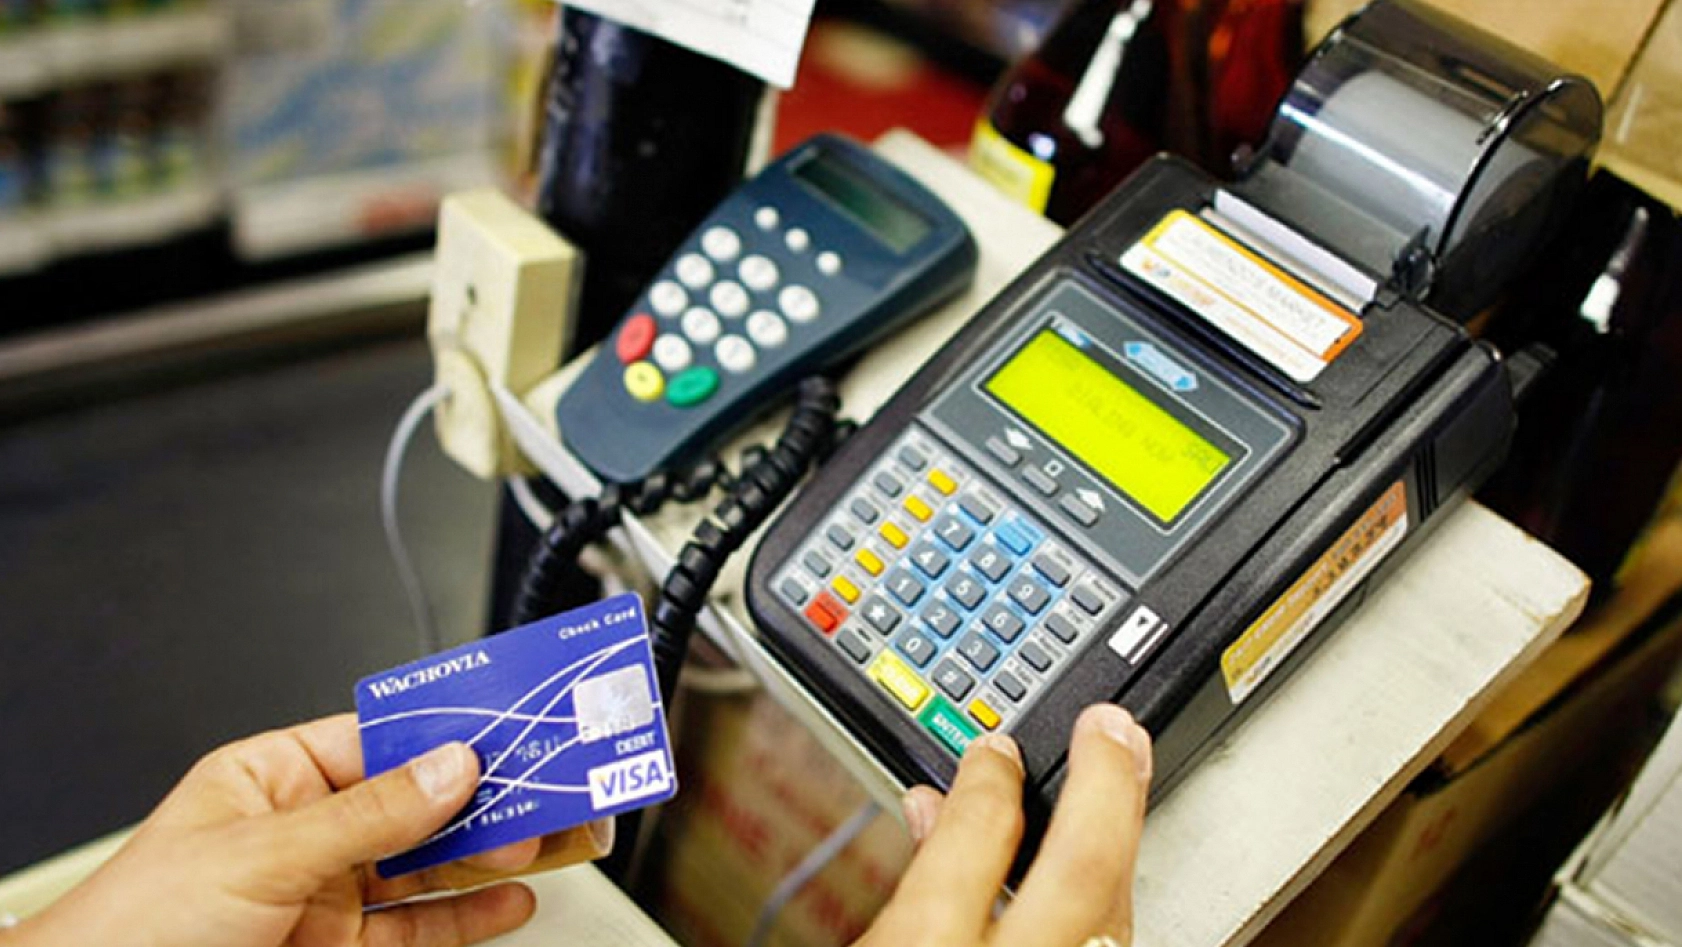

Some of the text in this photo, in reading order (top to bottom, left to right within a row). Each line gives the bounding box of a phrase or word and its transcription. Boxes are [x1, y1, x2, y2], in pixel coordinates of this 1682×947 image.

[944, 521, 960, 538] 7
[918, 550, 934, 567] 4
[980, 553, 996, 569] 8
[895, 577, 910, 594] 1
[954, 580, 971, 597] 5
[1018, 583, 1034, 599] 9
[558, 606, 637, 640] Check Card
[930, 608, 947, 625] 2
[993, 611, 1008, 628] 6
[905, 637, 921, 655] 0
[967, 640, 983, 657] 3
[368, 650, 490, 699] WACHOVIA
[599, 758, 664, 798] VISA
